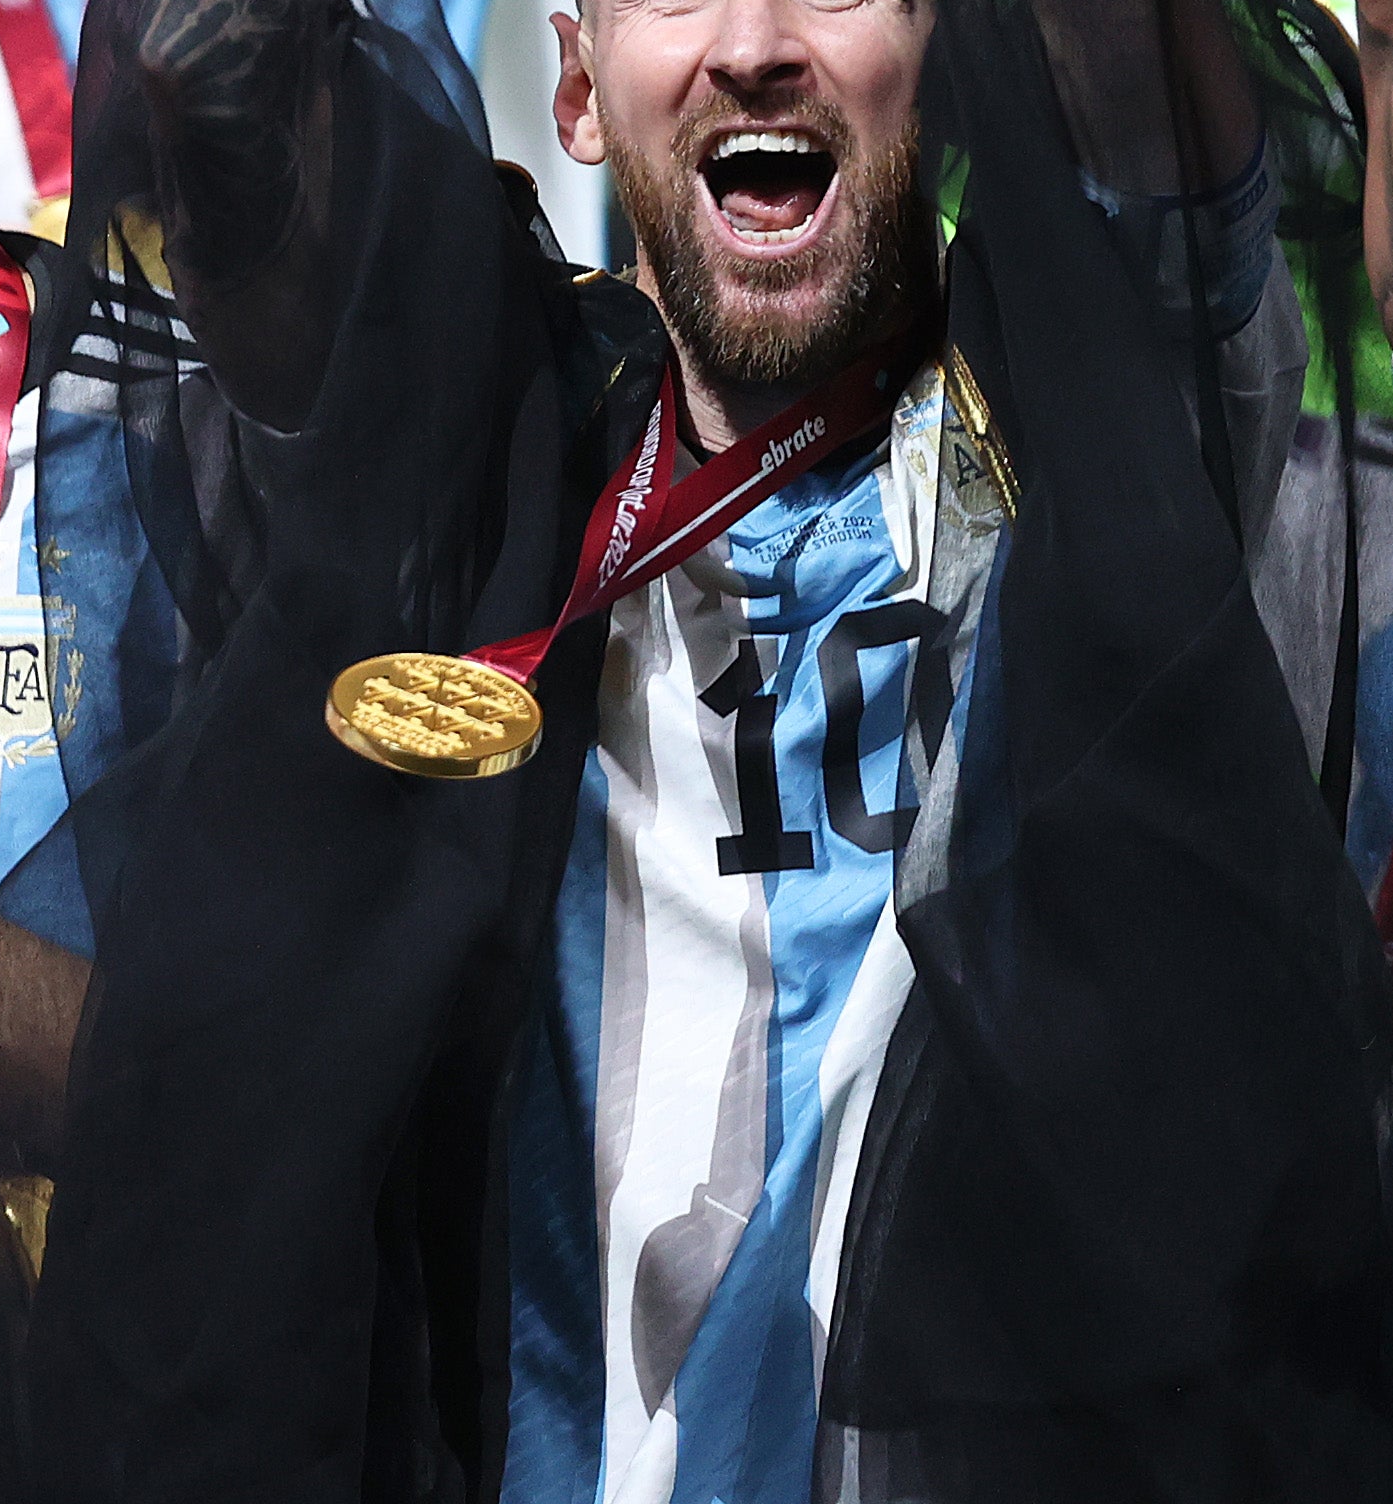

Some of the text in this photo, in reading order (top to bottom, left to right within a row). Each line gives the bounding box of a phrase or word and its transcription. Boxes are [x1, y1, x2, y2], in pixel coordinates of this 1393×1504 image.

[841, 515, 876, 528] 2022
[811, 528, 873, 550] STADIUM
[697, 598, 955, 877] 10
